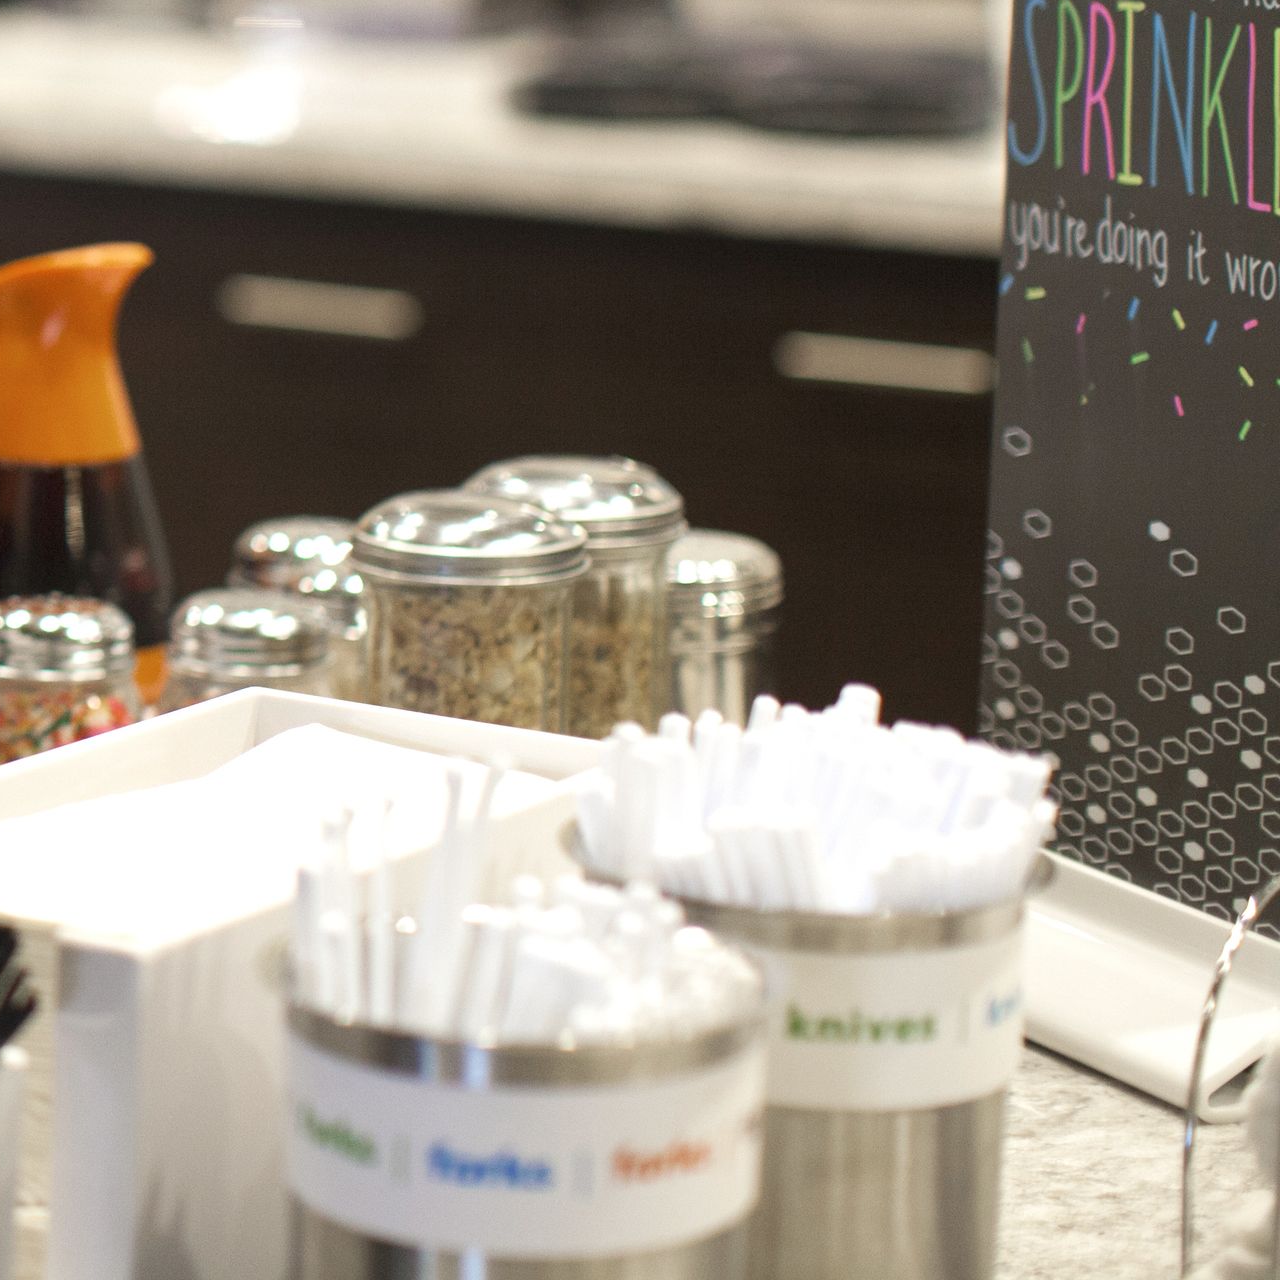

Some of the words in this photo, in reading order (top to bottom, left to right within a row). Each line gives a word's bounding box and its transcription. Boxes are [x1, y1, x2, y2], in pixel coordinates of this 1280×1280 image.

[1010, 196, 1094, 271] you're
[1096, 194, 1169, 288] doing
[1187, 230, 1210, 286] it
[1225, 251, 1279, 301] wro
